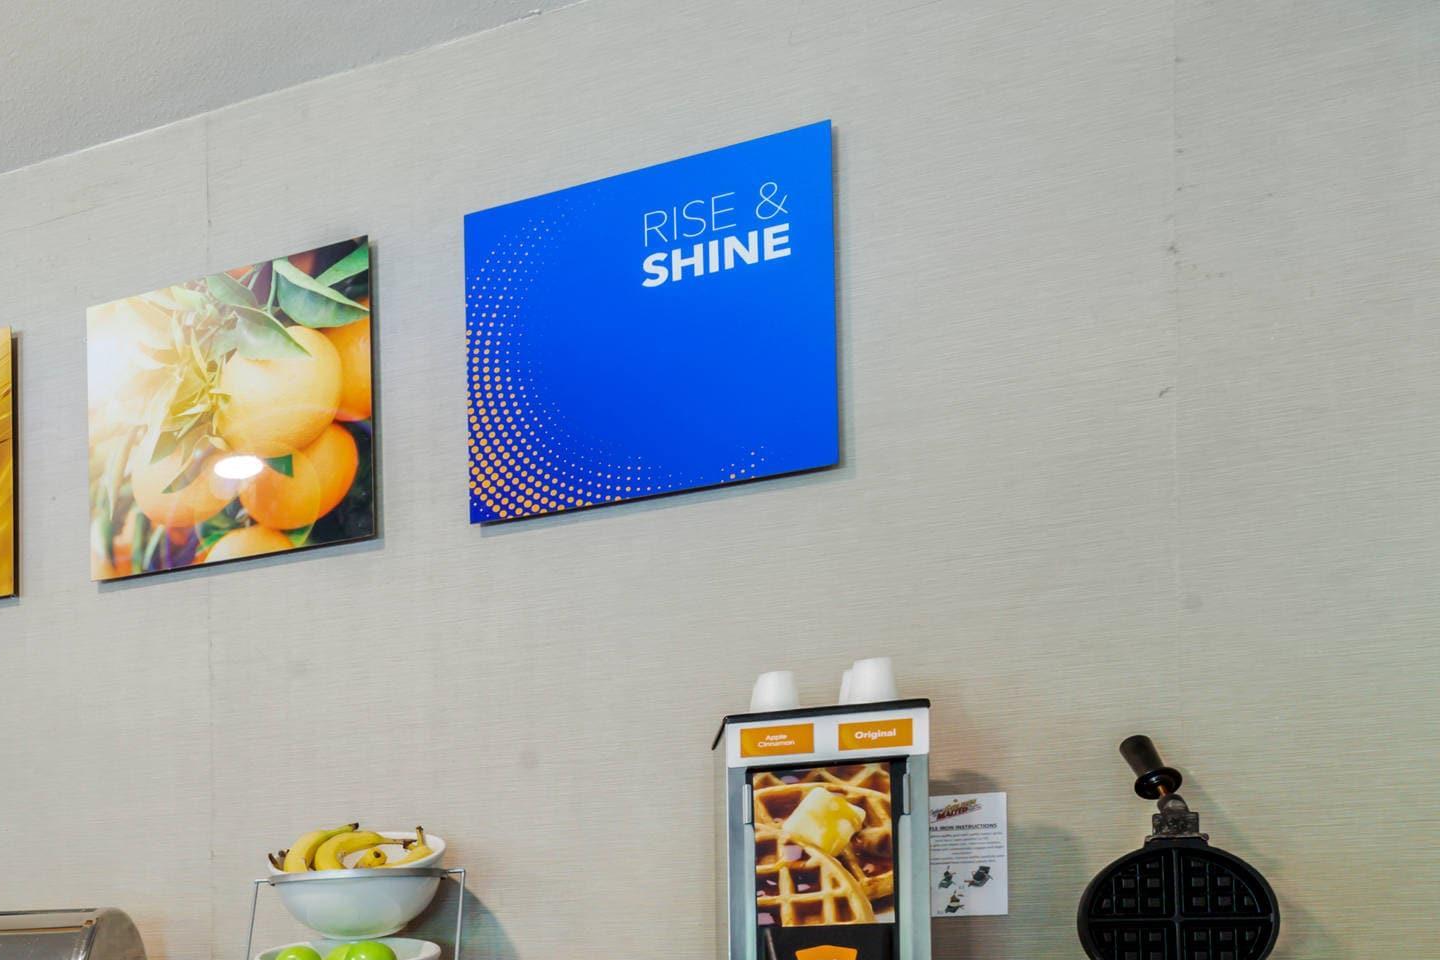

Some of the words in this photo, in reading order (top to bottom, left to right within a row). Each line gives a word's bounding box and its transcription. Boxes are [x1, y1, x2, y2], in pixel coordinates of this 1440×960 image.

[644, 191, 737, 247] RISE
[755, 181, 789, 220] &
[641, 223, 792, 288] SHINE
[854, 728, 897, 741] Original
